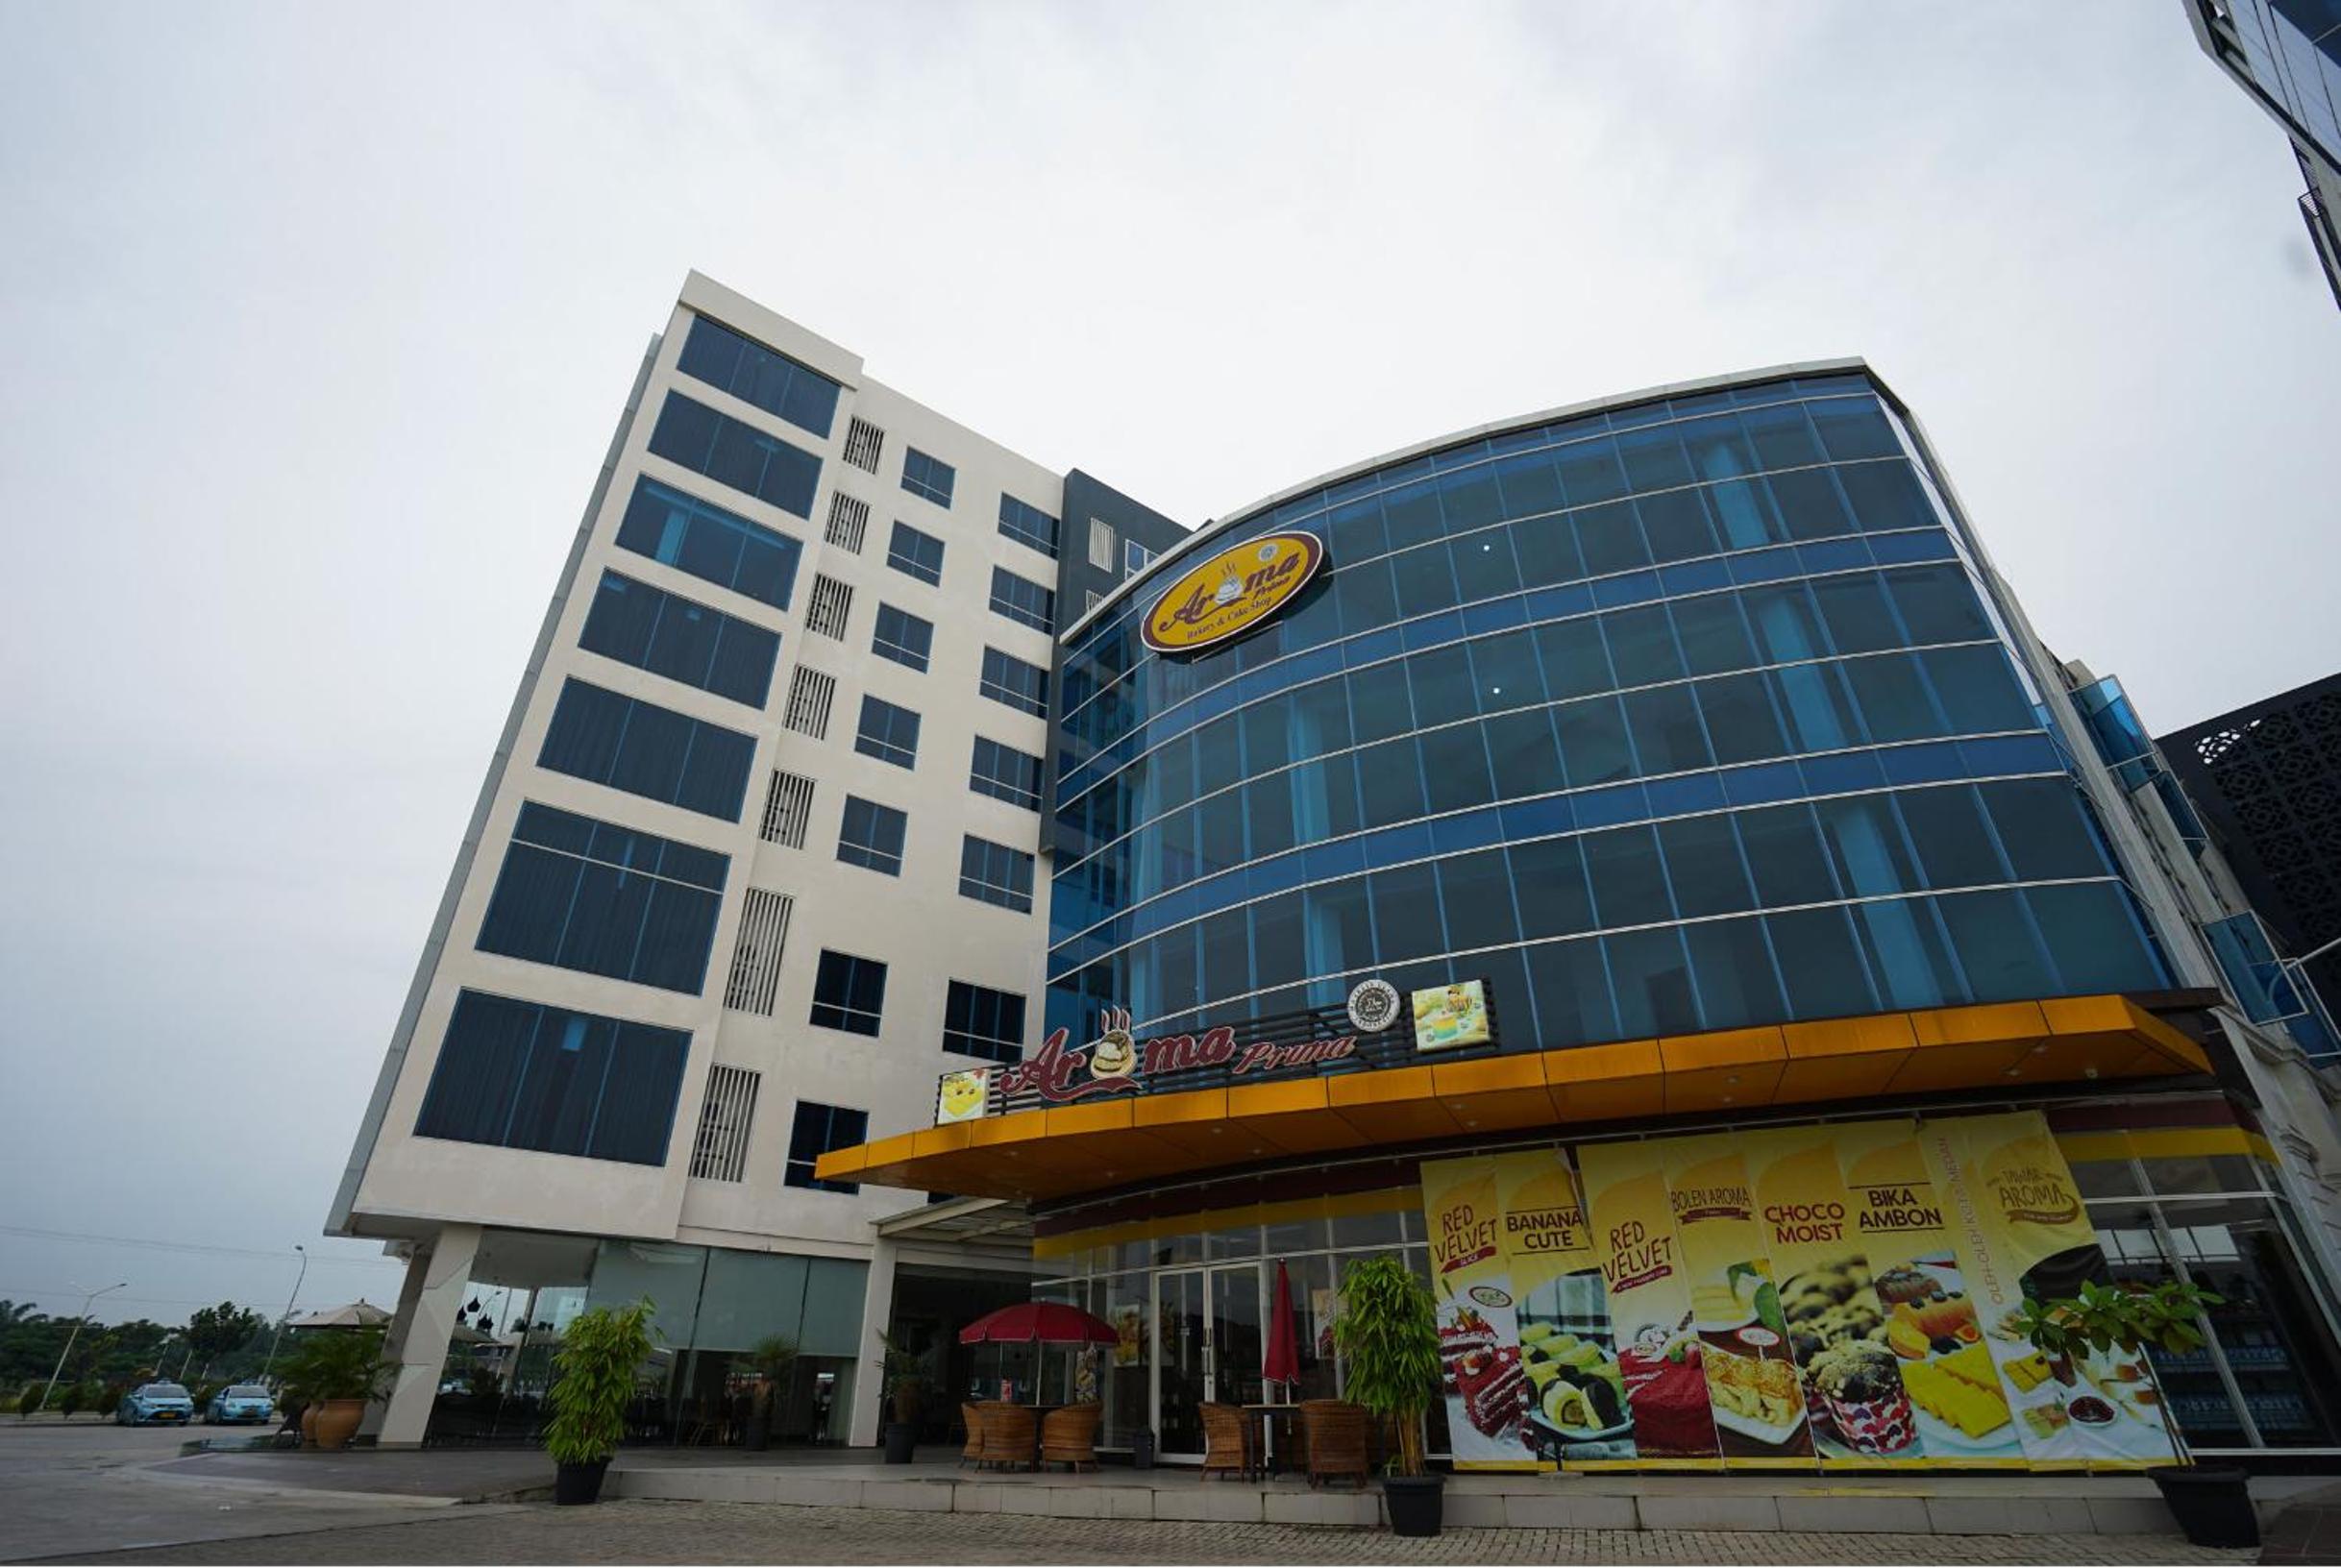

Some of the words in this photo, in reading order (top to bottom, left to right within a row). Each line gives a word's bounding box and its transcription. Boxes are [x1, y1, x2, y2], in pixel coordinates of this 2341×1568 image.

[1231, 1035, 1358, 1074] Prima
[1670, 1188, 1707, 1212] BOLEN
[1708, 1186, 1753, 1208] AROMA
[1867, 1188, 1917, 1208] BIKA
[1998, 1183, 2066, 1209] AROMA
[1442, 1205, 1474, 1236] RED
[1506, 1209, 1584, 1233] BANANA
[1764, 1203, 1845, 1224] CHOCO
[1860, 1208, 1942, 1229] AMBON
[1434, 1218, 1497, 1263] VELVET
[1523, 1230, 1574, 1249] CUTE
[1610, 1220, 1645, 1253] RED
[1776, 1222, 1843, 1244] MOIST
[1602, 1237, 1672, 1283] VELVET
